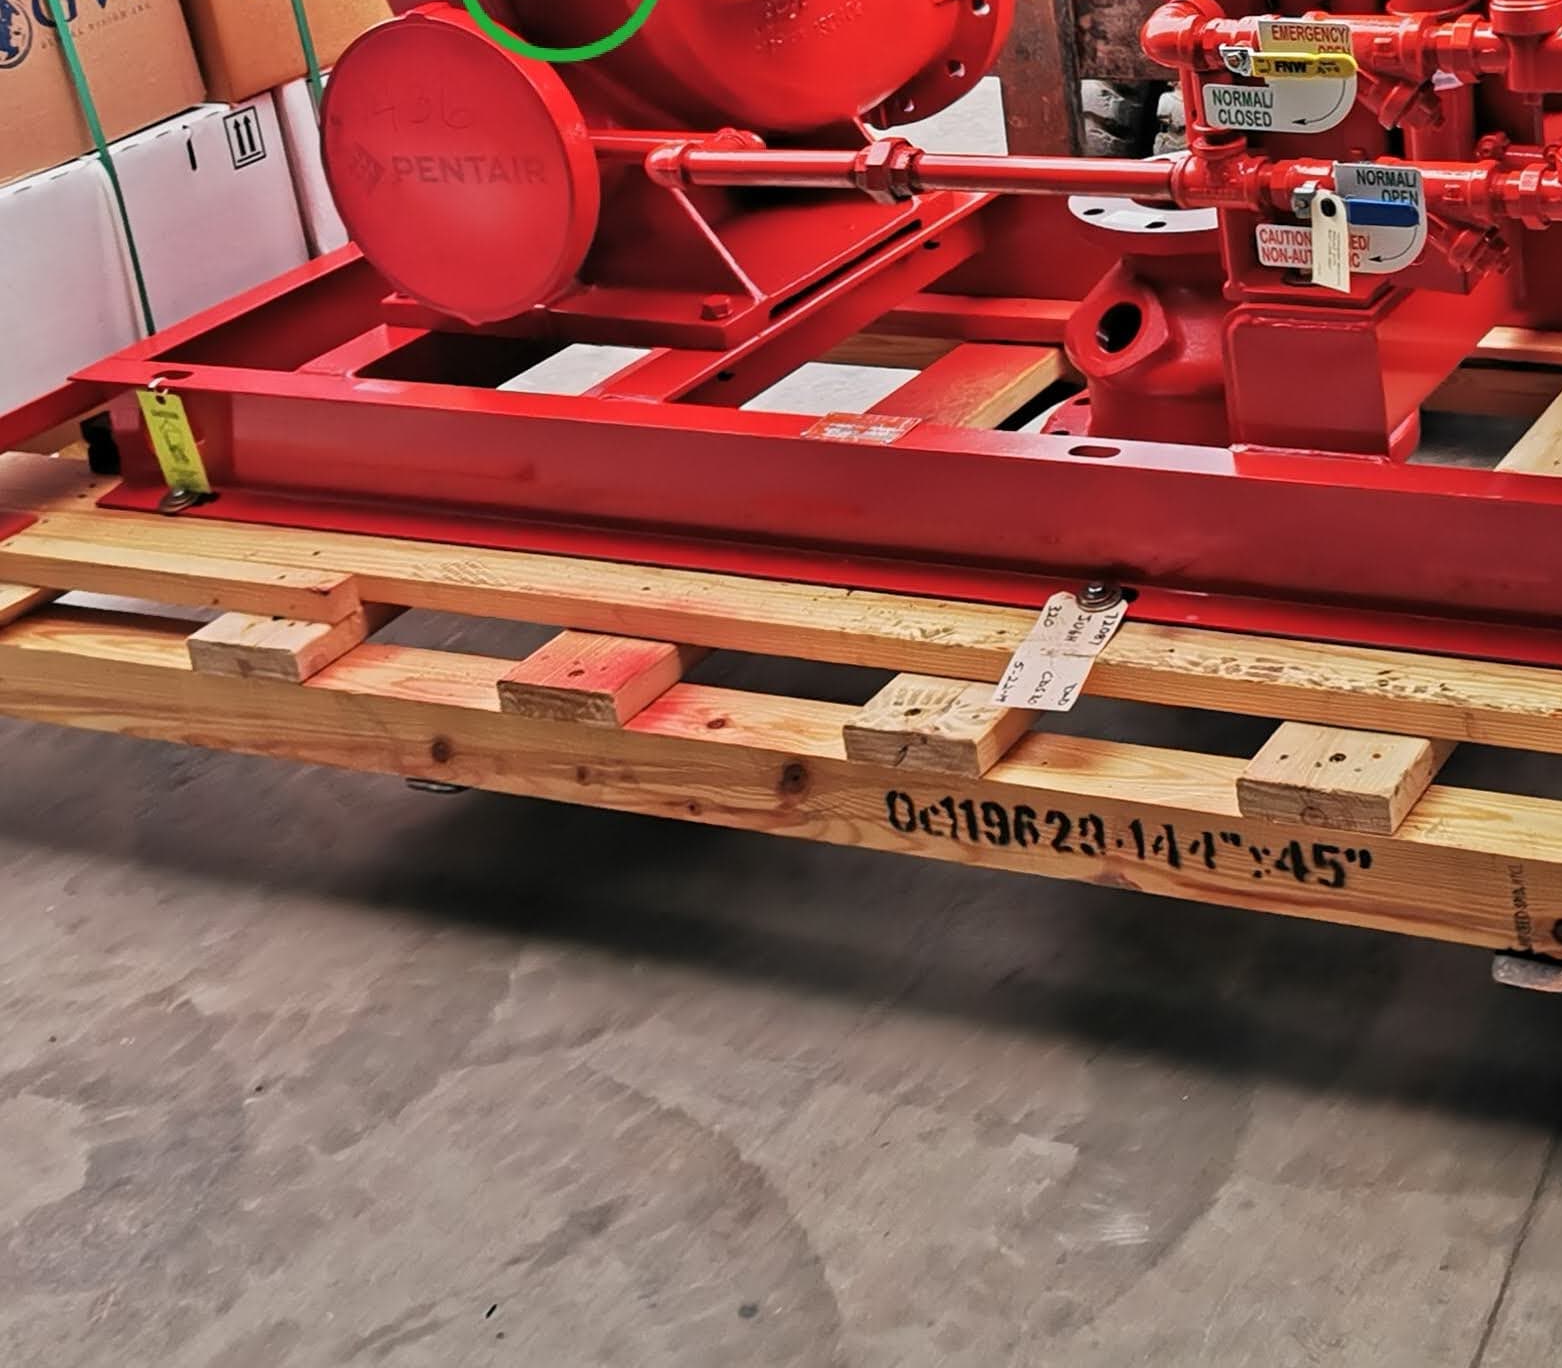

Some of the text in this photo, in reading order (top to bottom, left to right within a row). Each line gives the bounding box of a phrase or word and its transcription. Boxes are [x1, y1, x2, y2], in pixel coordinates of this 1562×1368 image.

[1212, 89, 1274, 108] NORMAL/
[1218, 109, 1272, 127] CLOSED
[391, 153, 546, 184] PENTAIR
[1356, 169, 1418, 187] NORMAL/
[1259, 228, 1312, 247] CAUTION
